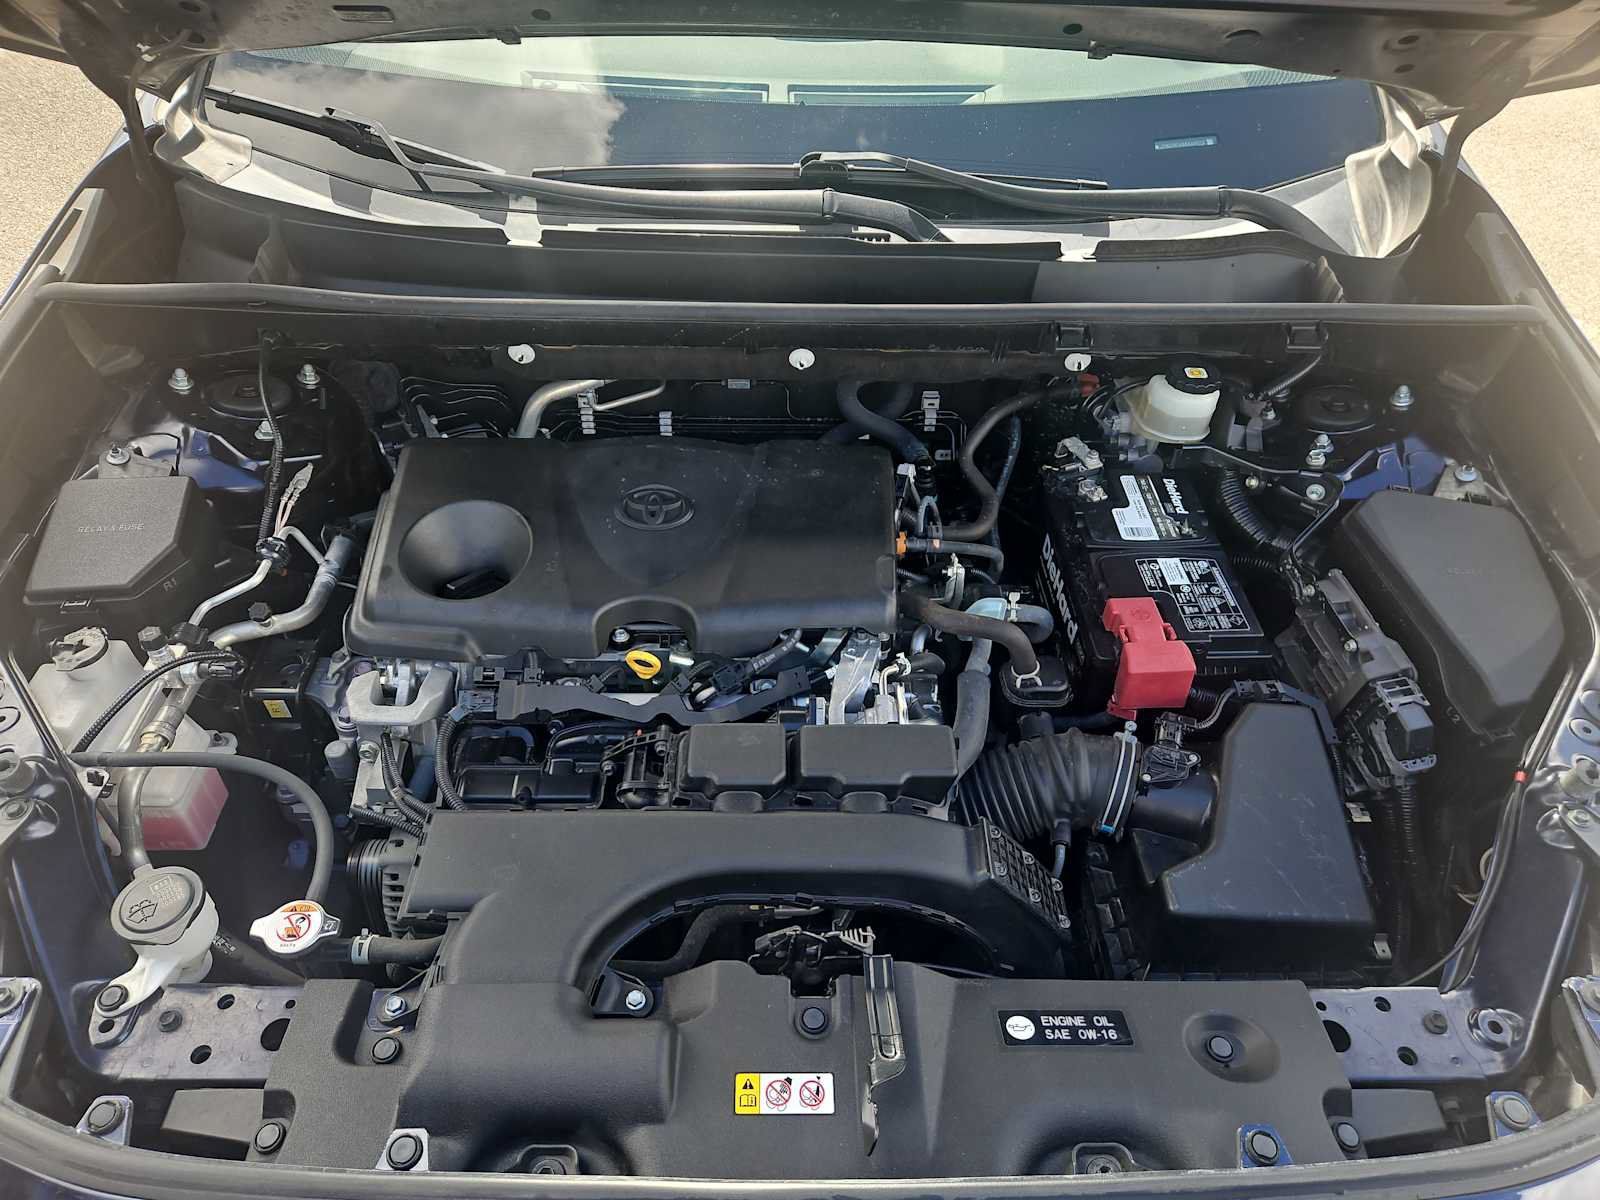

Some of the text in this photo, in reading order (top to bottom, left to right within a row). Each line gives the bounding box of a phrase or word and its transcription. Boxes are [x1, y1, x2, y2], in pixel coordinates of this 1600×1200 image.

[1162, 478, 1189, 515] DieHard
[1042, 533, 1079, 645] DieHard
[1040, 1015, 1114, 1027] ENGINE OIL
[1045, 1029, 1118, 1040] SAE 0W-16
